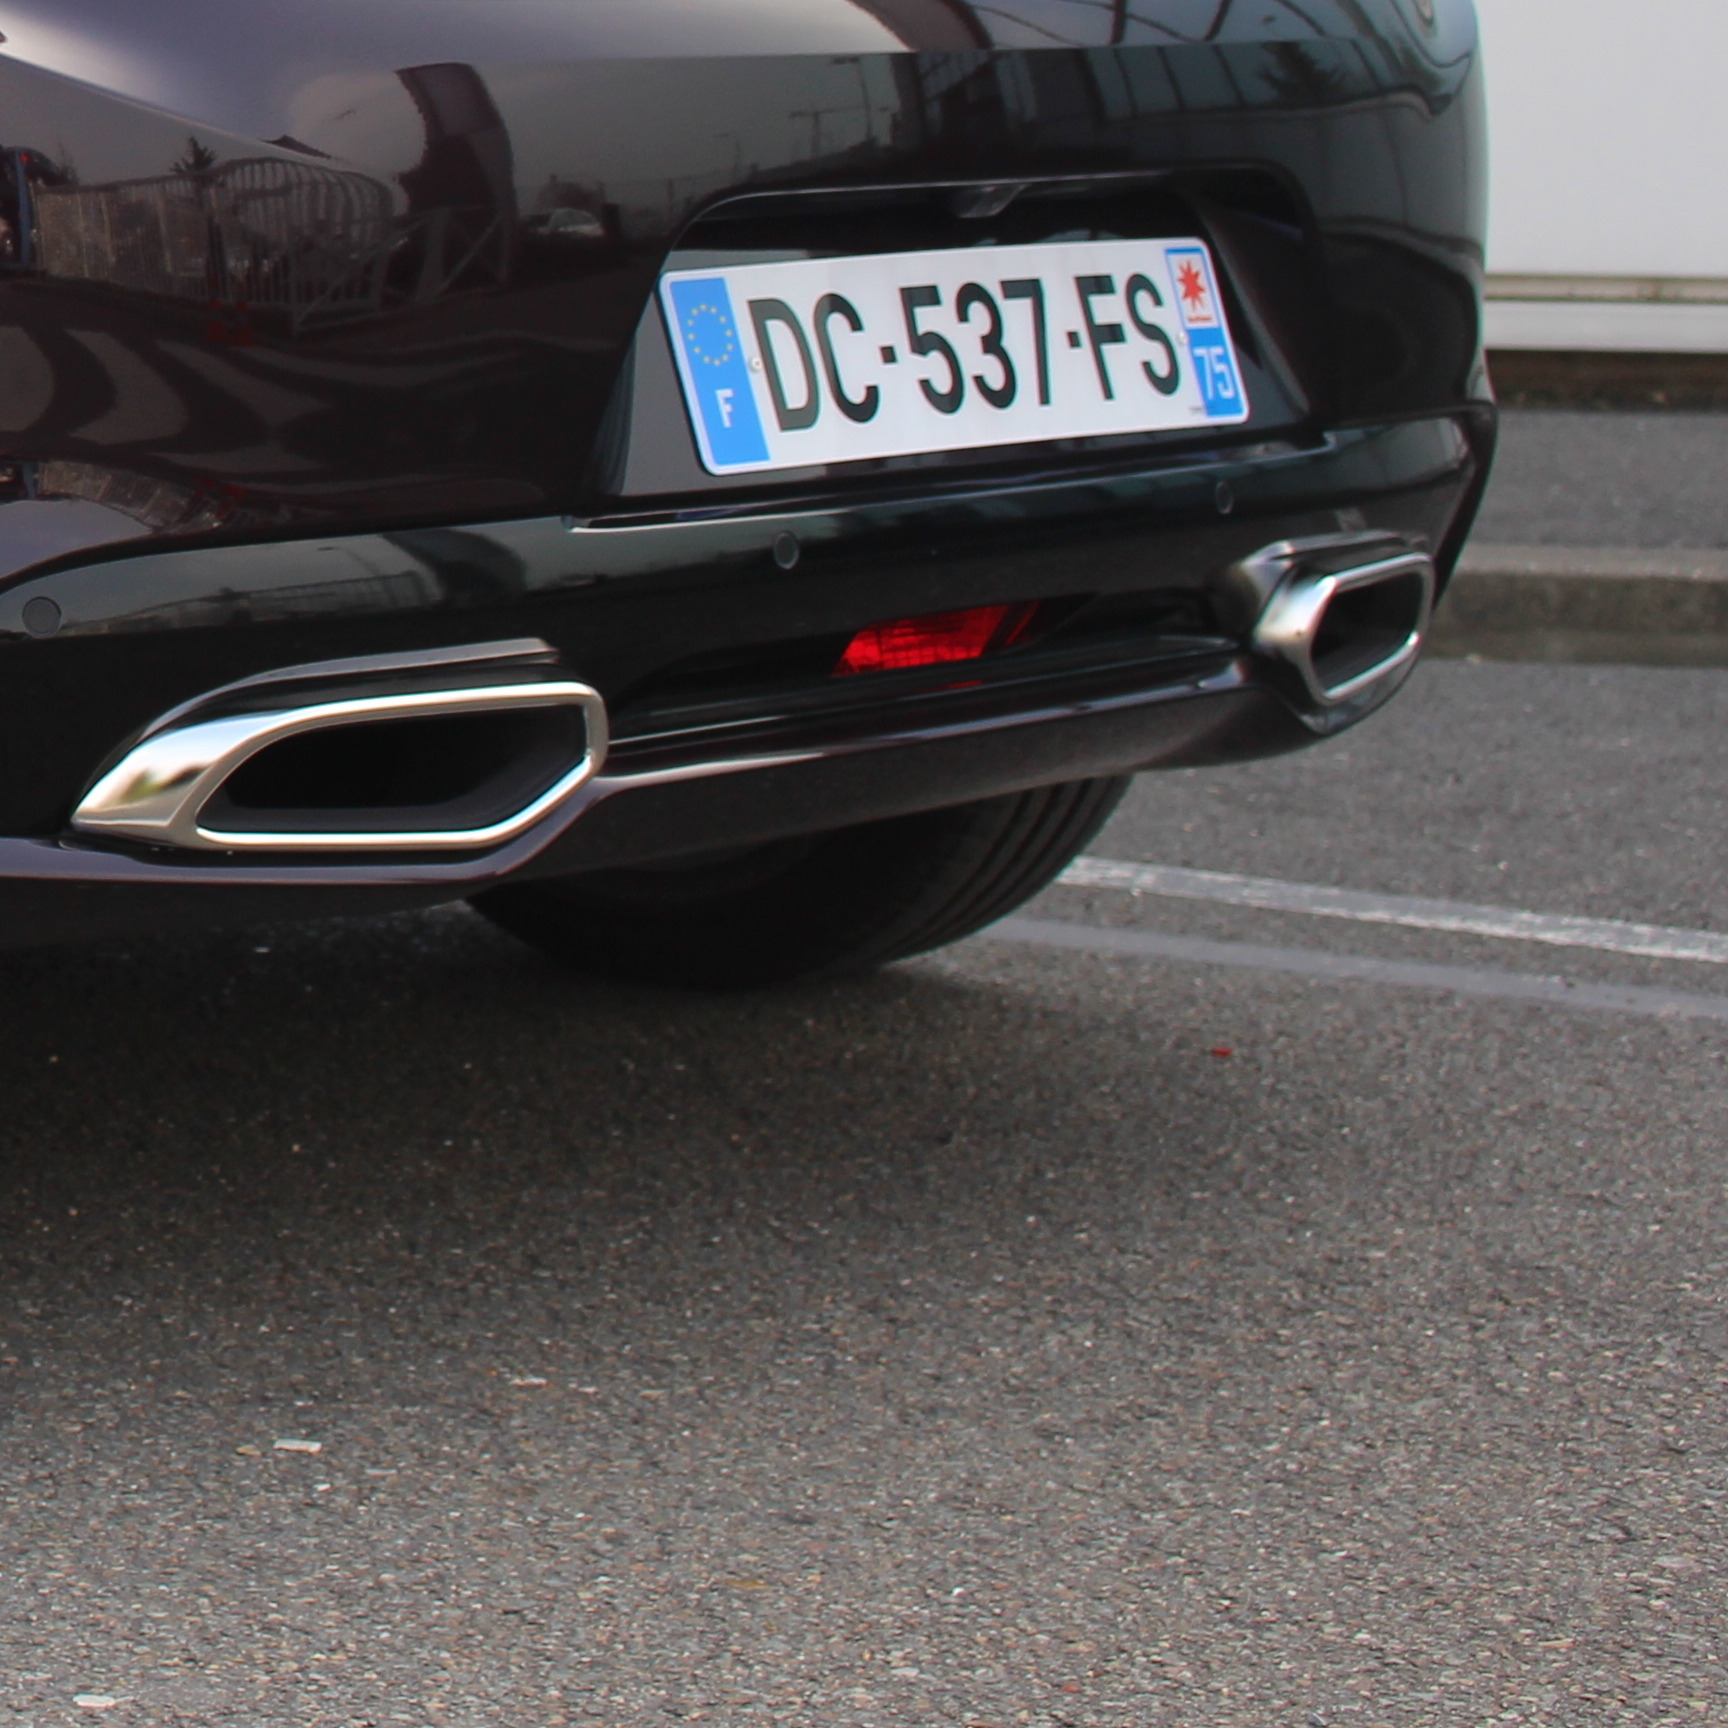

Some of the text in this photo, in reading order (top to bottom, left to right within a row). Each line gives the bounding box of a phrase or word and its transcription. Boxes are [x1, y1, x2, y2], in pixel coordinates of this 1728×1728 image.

[747, 273, 1181, 433] DC-537-FS
[1192, 346, 1236, 401] 75
[716, 387, 736, 429] F
